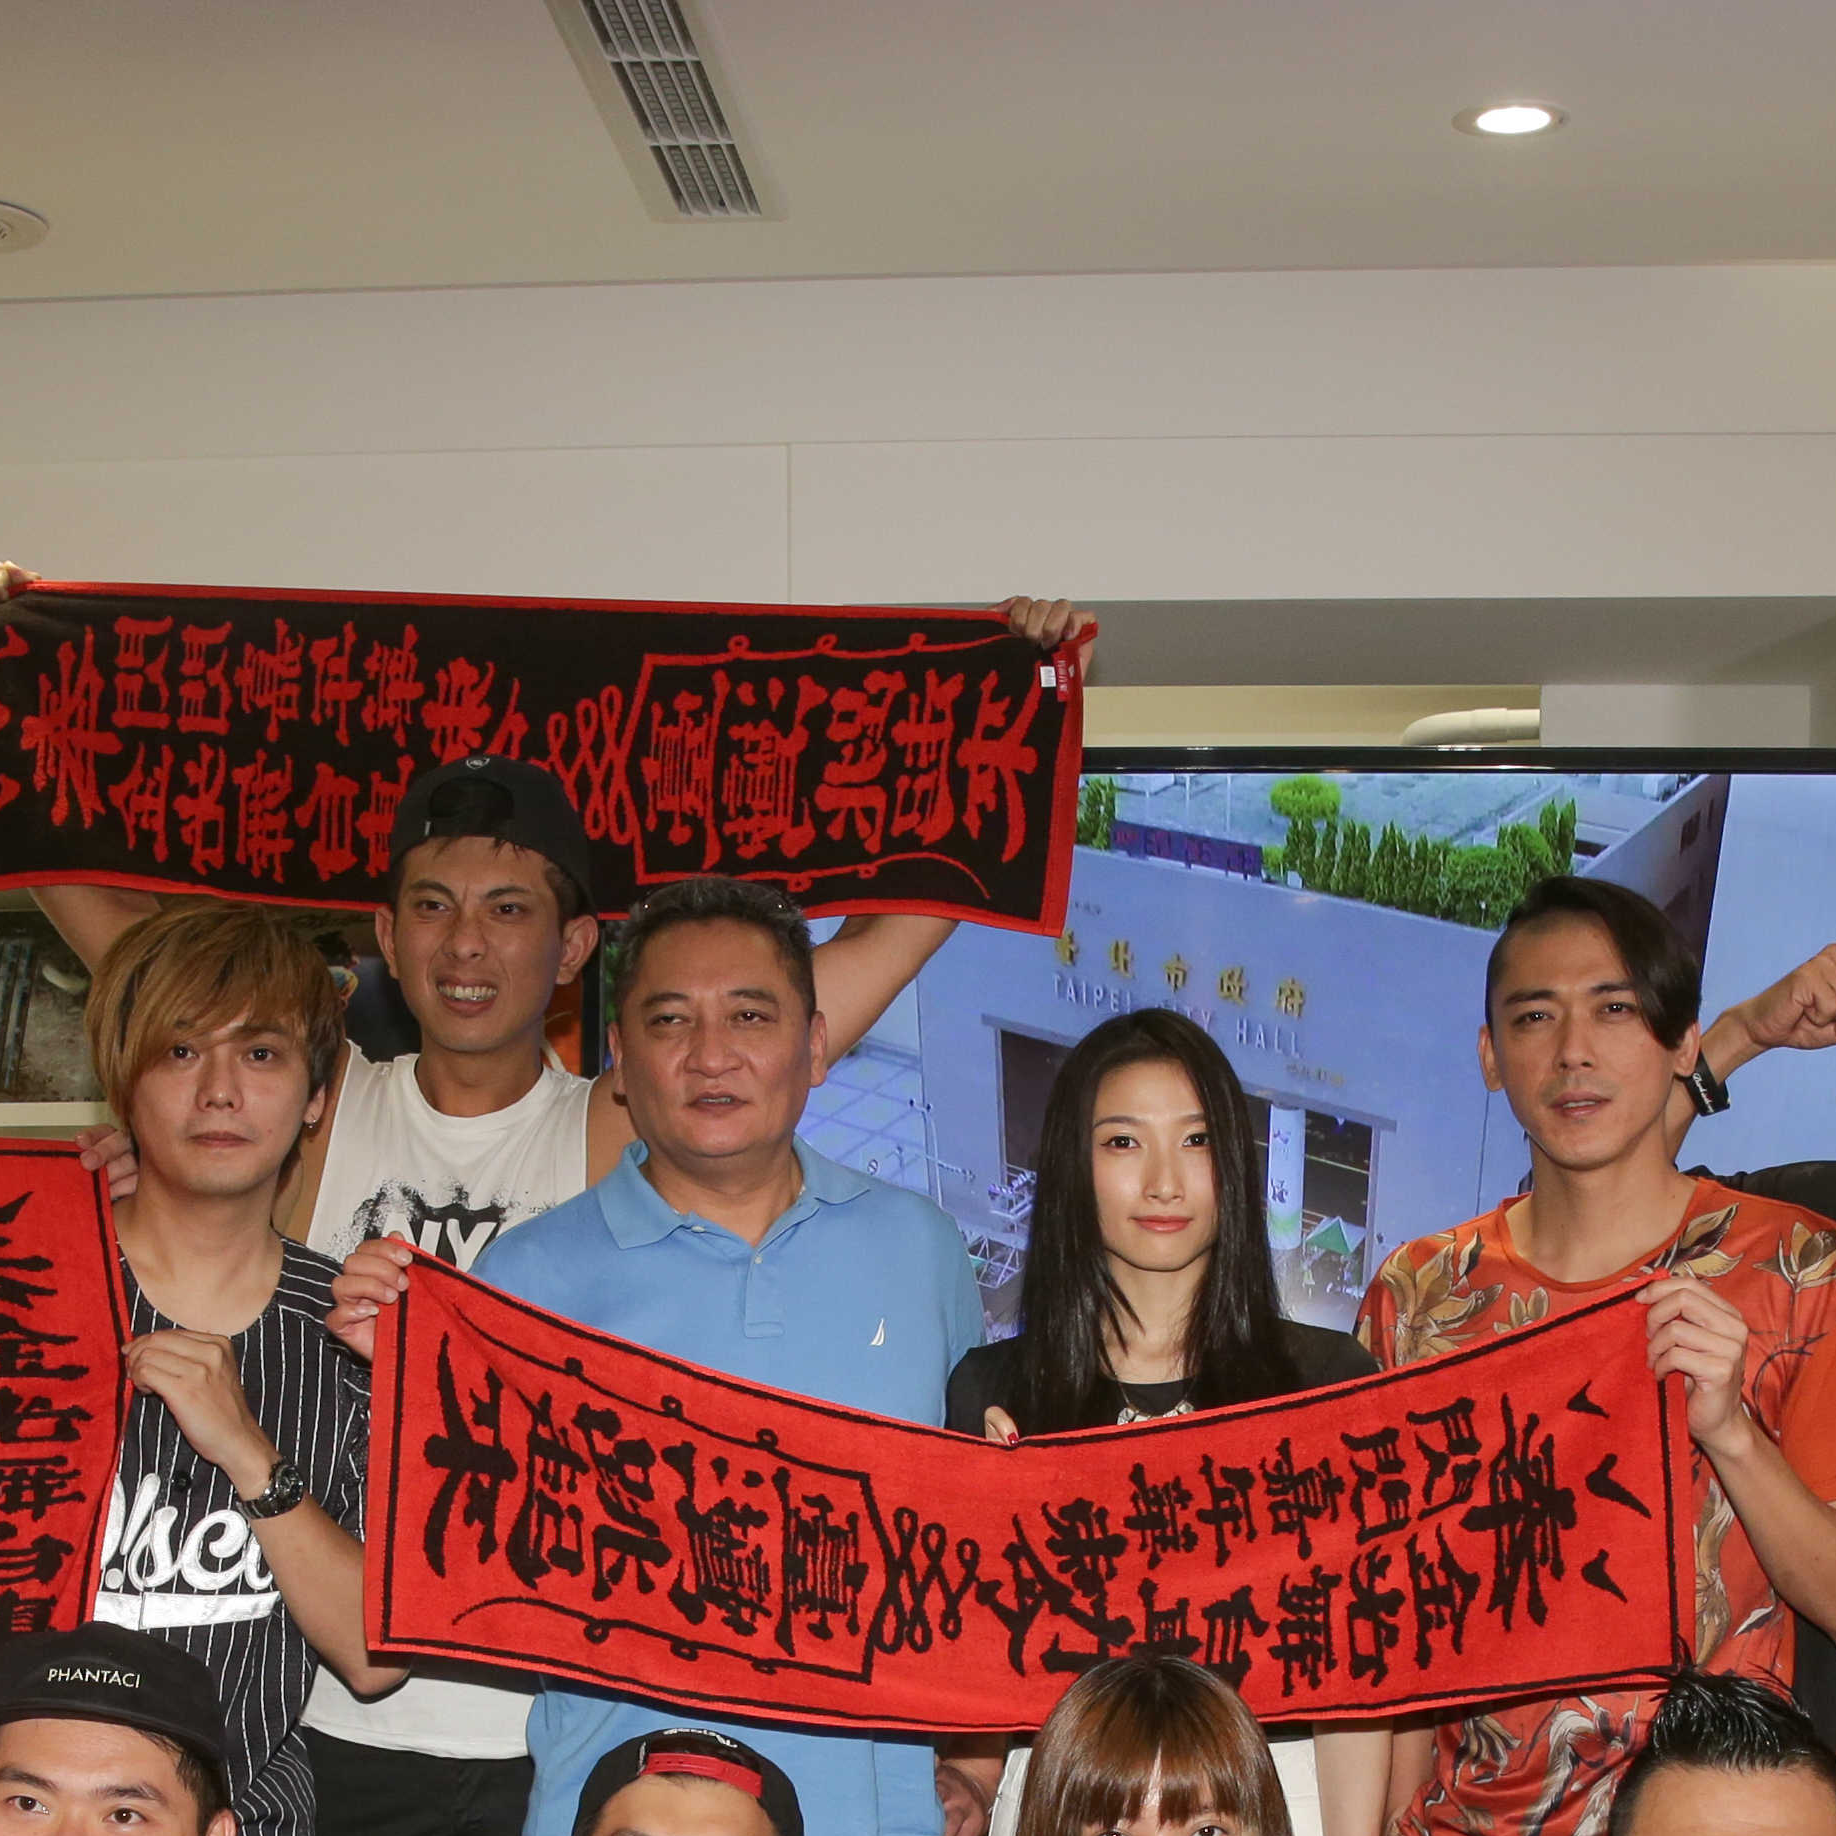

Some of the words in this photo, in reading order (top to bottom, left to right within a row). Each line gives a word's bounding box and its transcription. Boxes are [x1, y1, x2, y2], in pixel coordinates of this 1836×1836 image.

[1052, 973, 1133, 1014] TAIPEI
[1236, 1017, 1303, 1059] HALL
[1489, 1391, 1579, 1632] 奉
[47, 1668, 141, 1689] PHANTACI
